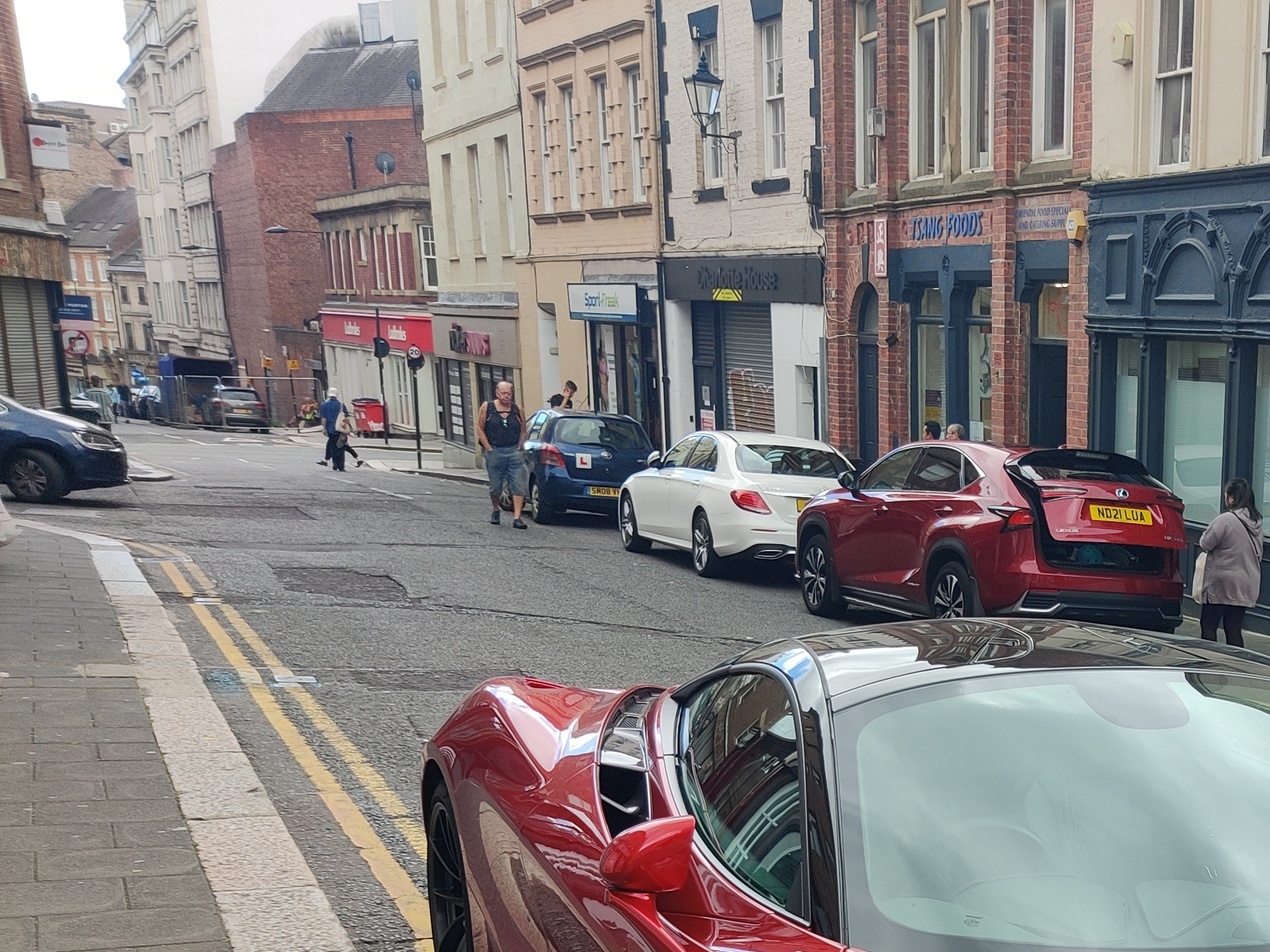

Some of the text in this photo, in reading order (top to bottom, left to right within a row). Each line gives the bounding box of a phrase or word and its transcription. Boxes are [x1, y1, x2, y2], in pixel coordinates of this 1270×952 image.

[1037, 206, 1051, 217] FOOD
[911, 210, 984, 241] TSANG FOODS
[744, 265, 779, 290] House
[409, 348, 420, 356] 20
[580, 456, 588, 466] L
[1097, 507, 1146, 522] ND21 LUA
